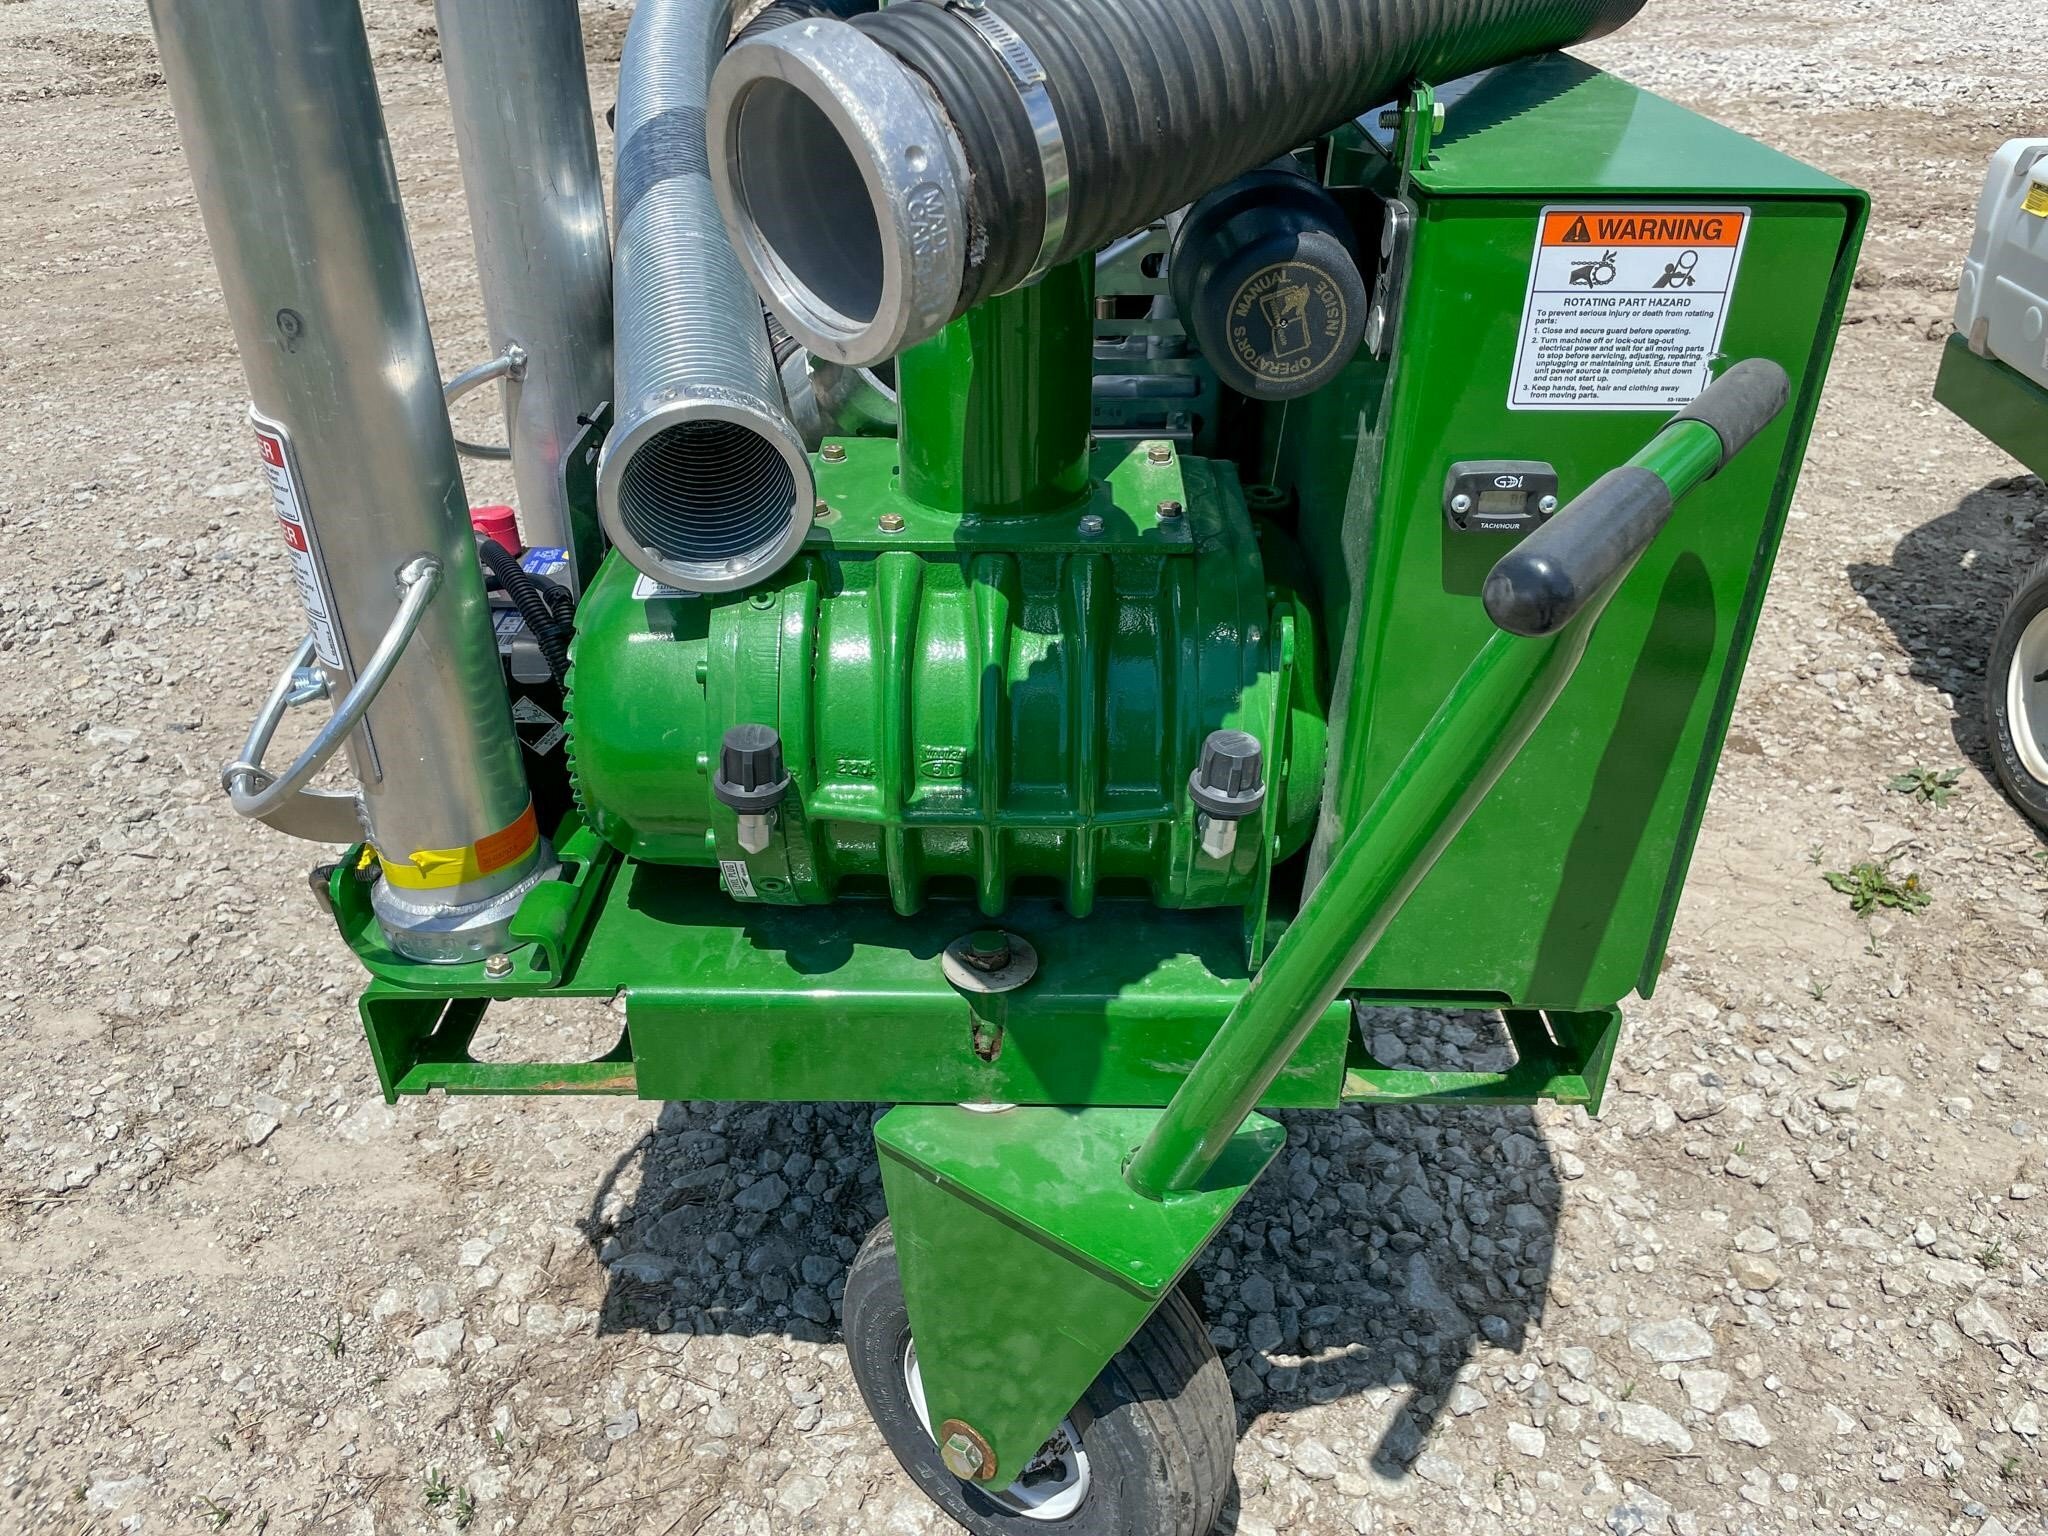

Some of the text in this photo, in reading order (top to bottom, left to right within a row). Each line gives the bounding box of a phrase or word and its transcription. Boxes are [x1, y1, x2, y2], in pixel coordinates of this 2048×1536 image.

[1597, 218, 1723, 241] WARNING
[1564, 298, 1692, 307] ROTATING PART HAZARD
[1313, 280, 1340, 337] INSIDE
[1537, 309, 1546, 317] To
[1548, 310, 1577, 318] prevent
[1608, 310, 1630, 318] injury
[1684, 310, 1714, 318] rotating
[1233, 270, 1311, 374] OPERATOR'S MANUAL
[1654, 328, 1691, 336] operating.
[1655, 345, 1683, 353] moving
[1685, 345, 1704, 353] parts
[1667, 353, 1702, 361] repairing,
[1536, 360, 1578, 368] unplugging
[1590, 360, 1633, 368] maintaining
[1611, 368, 1651, 376] completely
[1531, 384, 1550, 392] Keep
[1552, 384, 1577, 392] hands,
[1578, 384, 1595, 392] feet,
